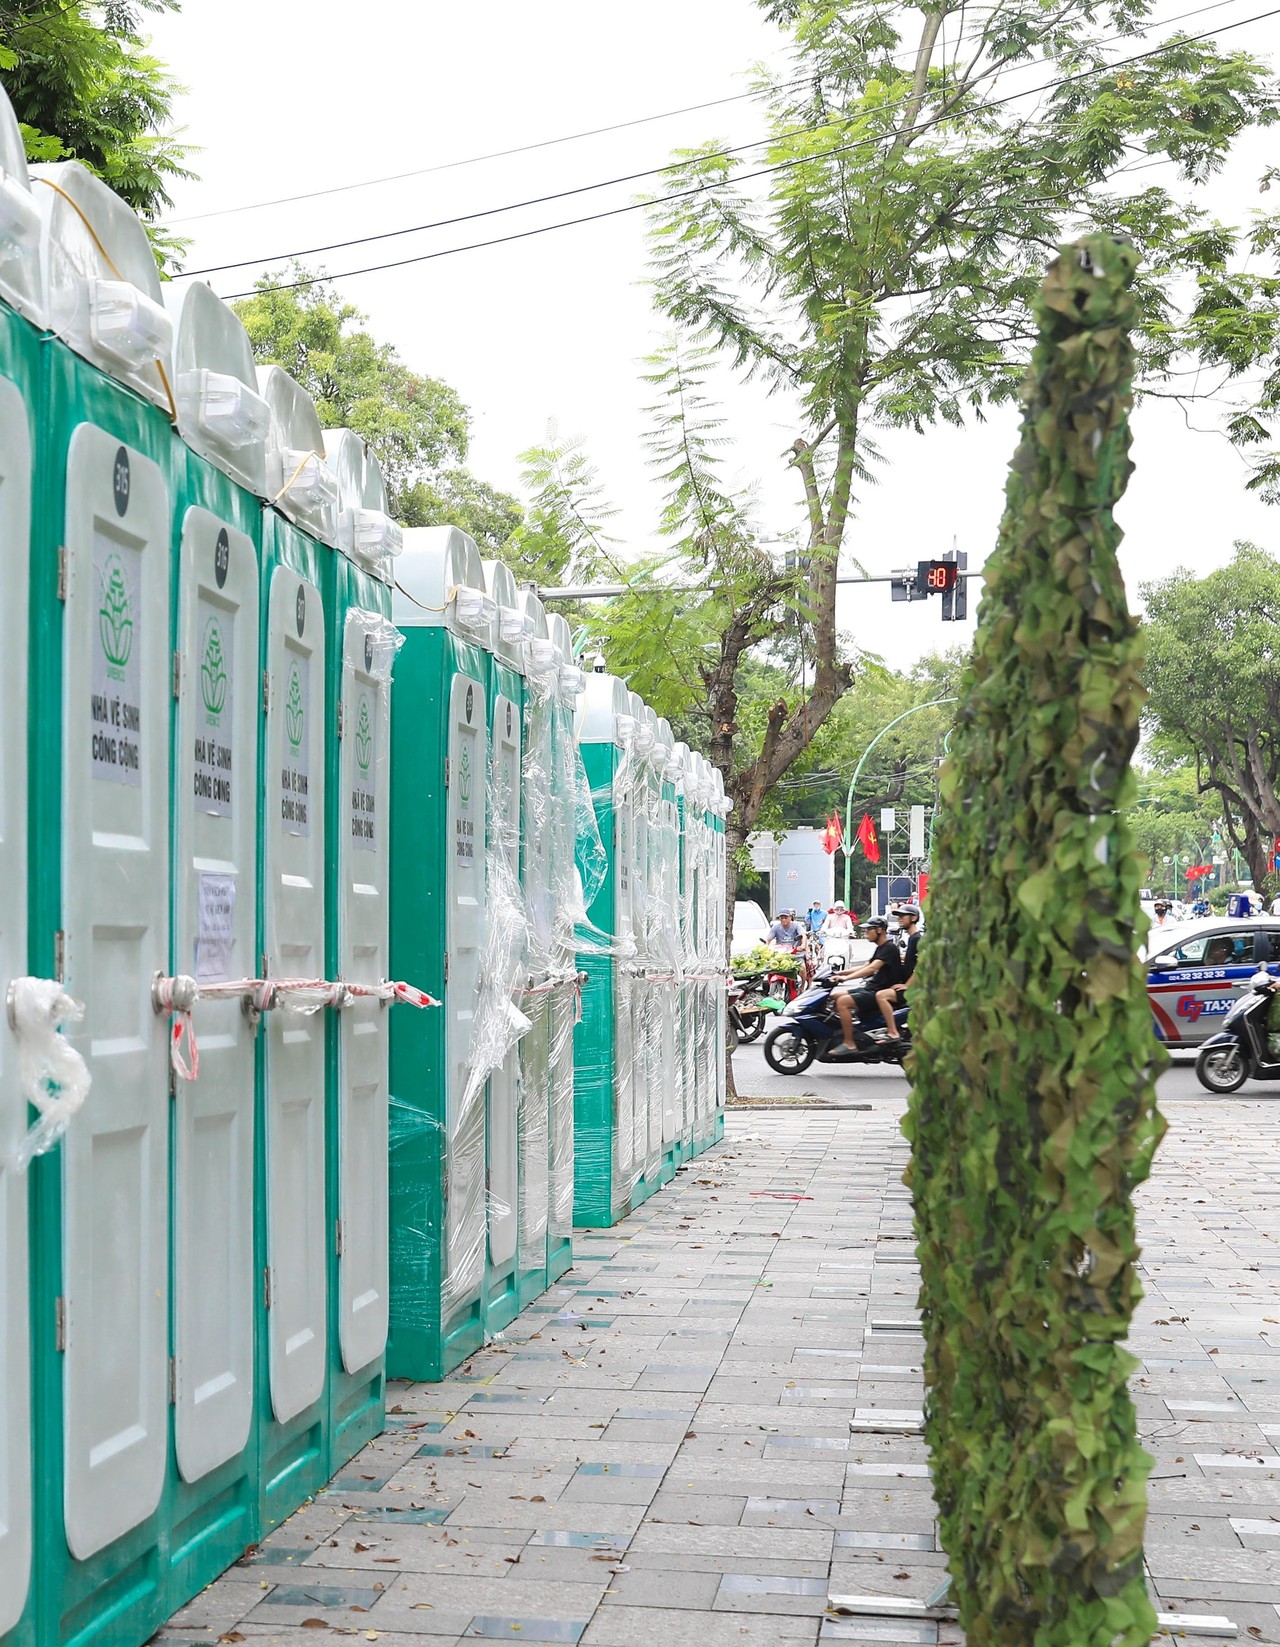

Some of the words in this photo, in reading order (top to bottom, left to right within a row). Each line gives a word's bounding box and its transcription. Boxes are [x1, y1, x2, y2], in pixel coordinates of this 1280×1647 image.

[116, 463, 128, 494] 315
[122, 703, 140, 733] SINH
[92, 730, 117, 765] CÔNG
[217, 746, 232, 771] SINH
[1180, 973, 1191, 981] 32
[1191, 972, 1203, 980] 32
[1203, 971, 1214, 979] 32
[1214, 970, 1226, 978] 32
